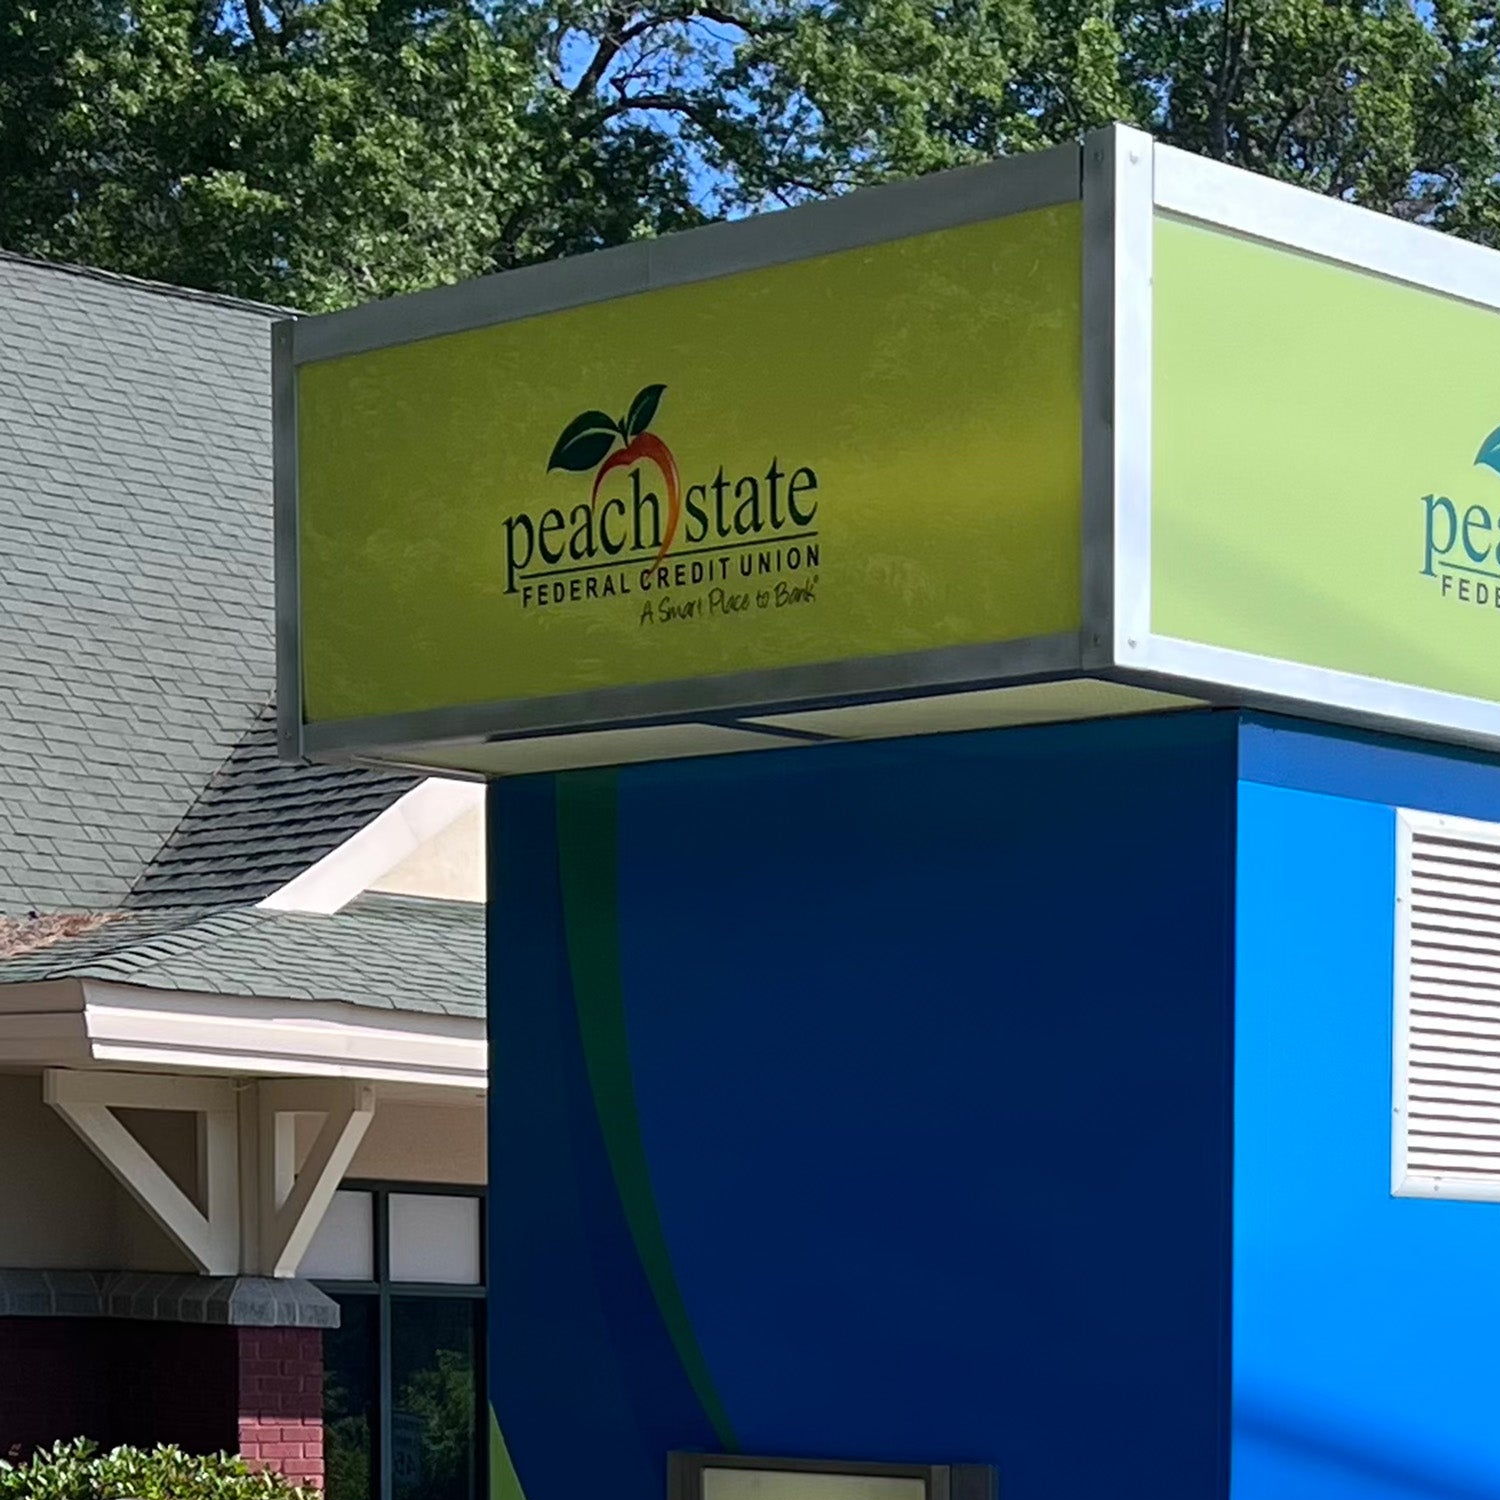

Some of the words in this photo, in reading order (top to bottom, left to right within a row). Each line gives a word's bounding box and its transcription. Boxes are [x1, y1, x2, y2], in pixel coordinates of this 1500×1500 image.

[502, 467, 664, 595] peach
[685, 456, 818, 543] state
[522, 572, 631, 608] FEDERAL
[640, 558, 731, 591] CREDIT
[740, 545, 819, 576] UNION
[640, 600, 653, 626] A
[658, 595, 701, 623] Smart
[708, 587, 749, 616] Place
[756, 590, 769, 608] to
